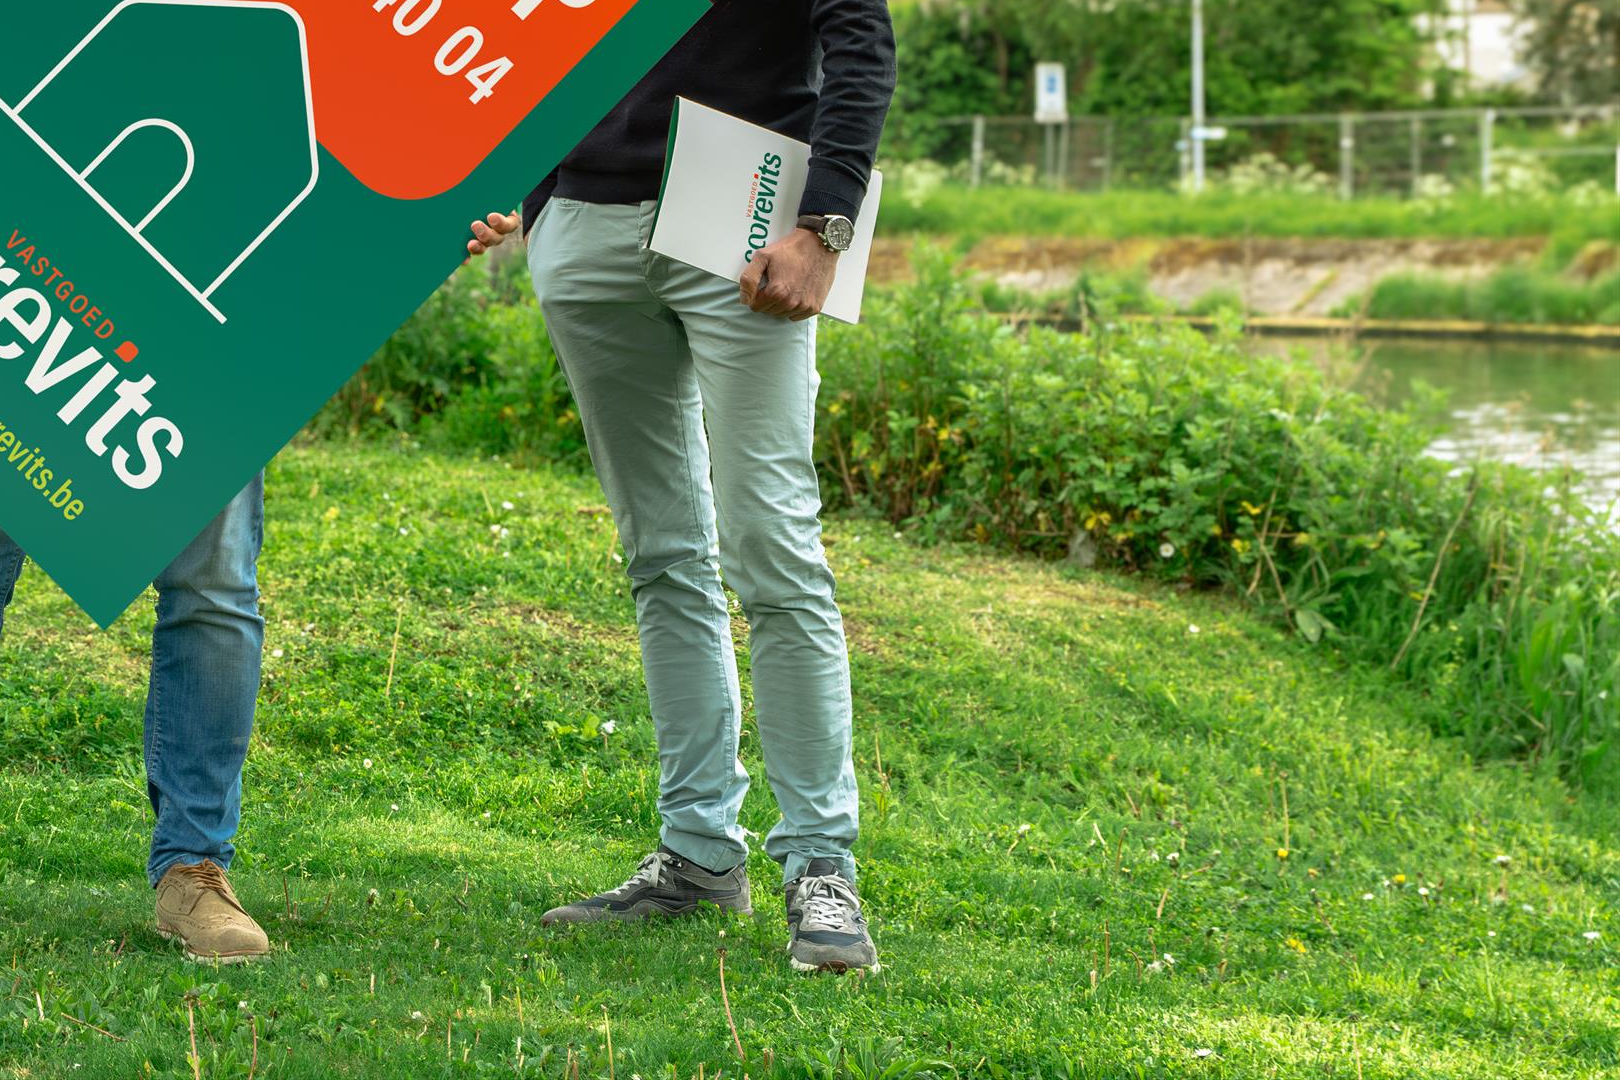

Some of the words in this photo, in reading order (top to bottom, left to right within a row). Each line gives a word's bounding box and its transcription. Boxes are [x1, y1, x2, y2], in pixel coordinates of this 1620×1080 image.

[434, 26, 514, 105] 04
[746, 181, 758, 218] VASTGOED
[6, 229, 115, 340] VASTGOED
